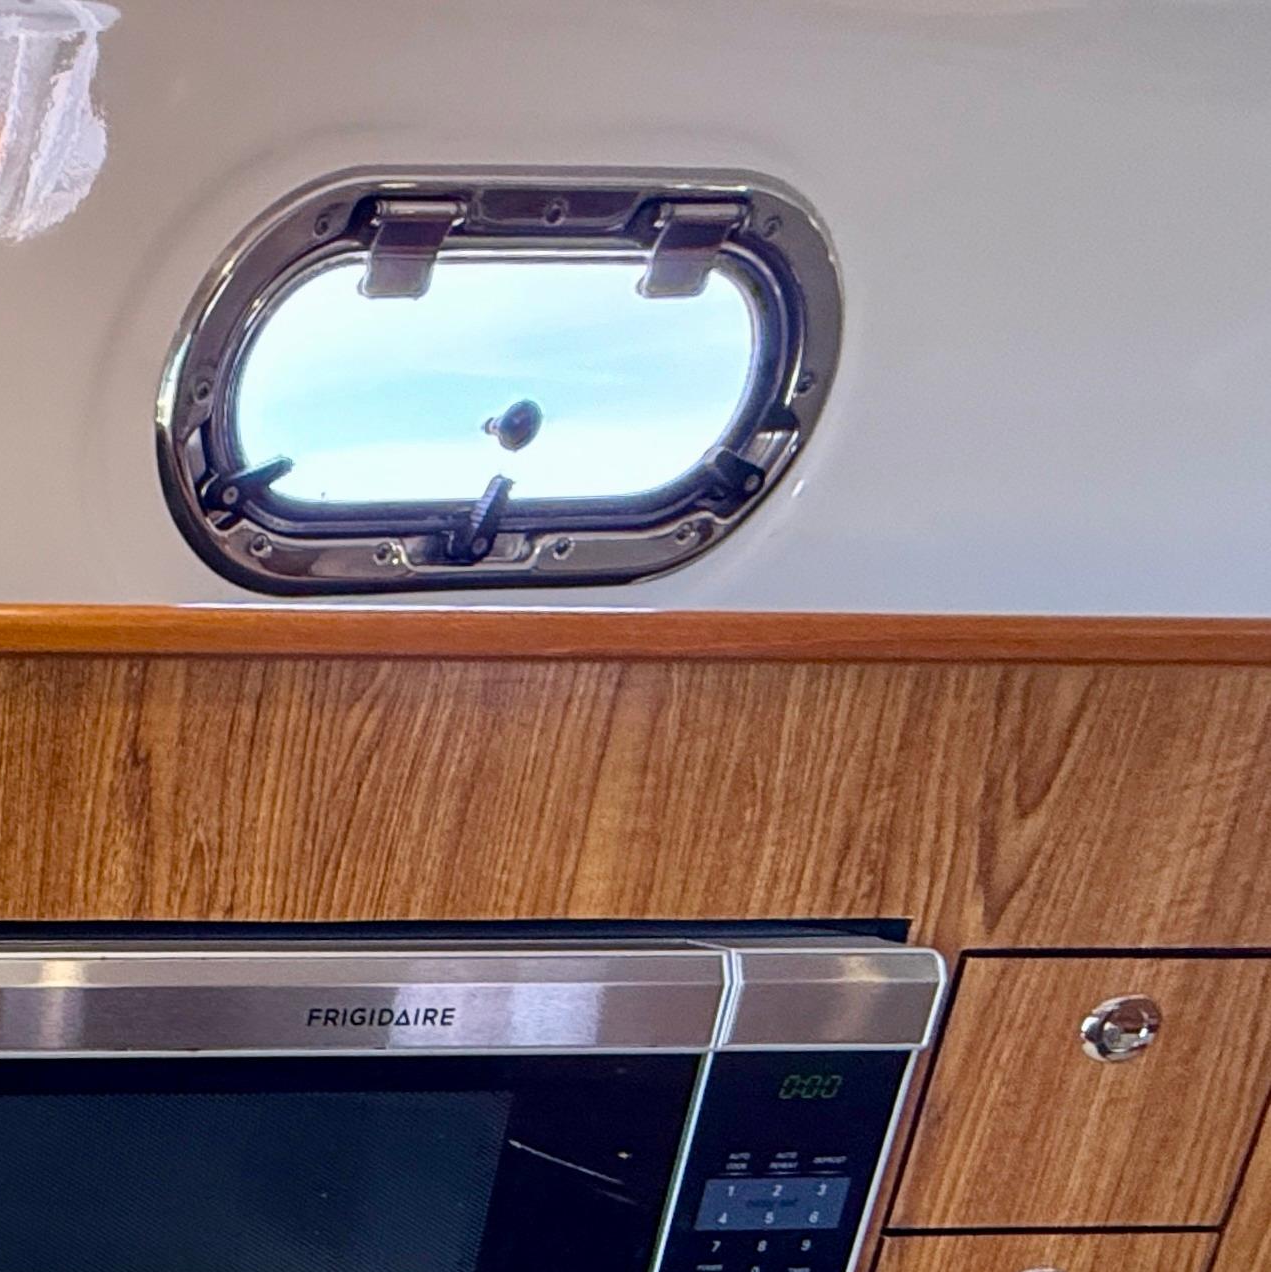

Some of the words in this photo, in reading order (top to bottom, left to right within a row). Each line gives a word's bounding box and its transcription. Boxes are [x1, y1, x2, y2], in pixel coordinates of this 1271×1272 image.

[306, 1007, 456, 1027] FRIGIDAIRE
[727, 1185, 736, 1197] 1
[772, 1184, 783, 1197] 2
[817, 1183, 828, 1197] 3
[717, 1211, 728, 1224] 4
[764, 1211, 775, 1224] 5
[808, 1210, 820, 1224] 6
[711, 1240, 722, 1253] 7
[757, 1239, 768, 1253] 8
[800, 1238, 812, 1252] 9
